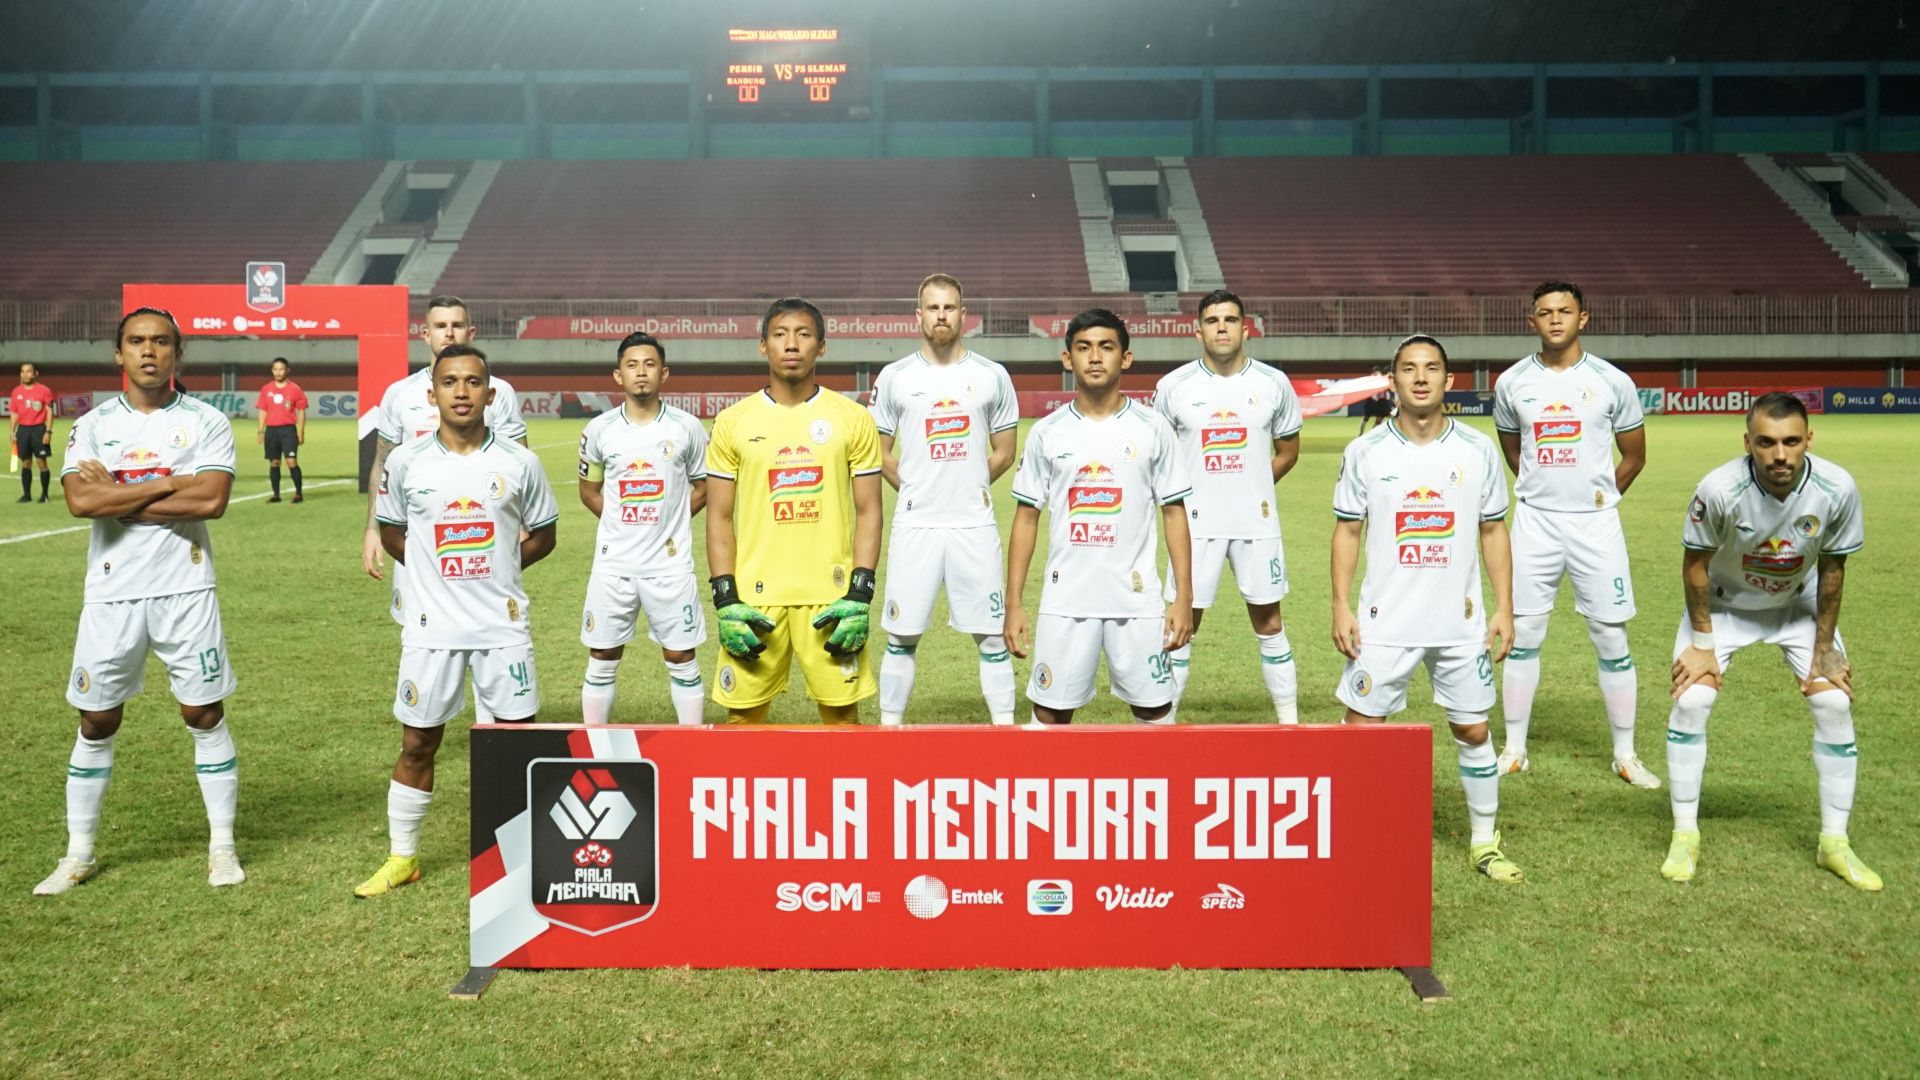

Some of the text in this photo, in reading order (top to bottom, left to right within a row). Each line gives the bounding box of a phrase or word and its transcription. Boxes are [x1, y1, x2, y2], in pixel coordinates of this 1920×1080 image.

[729, 65, 763, 73] PERSIB
[774, 64, 793, 80] VS
[795, 64, 847, 73] PS SLEMAN
[727, 77, 766, 85] BANDUNG
[570, 319, 738, 335] #DukungDariRumah
[1848, 397, 1875, 405] MILLS
[1898, 397, 1920, 405] MILL
[1614, 577, 1624, 597] 9
[683, 604, 694, 625] 3
[199, 648, 220, 675] 13
[509, 661, 529, 687] 41
[690, 777, 1331, 860] PIALA MENPORA 2021
[575, 868, 612, 882] PIALA
[546, 882, 640, 904] MENPORA
[776, 882, 862, 912] SCM
[951, 889, 1003, 905] Emtek
[1096, 884, 1174, 911] Vidio
[1201, 898, 1245, 909] SPECS
